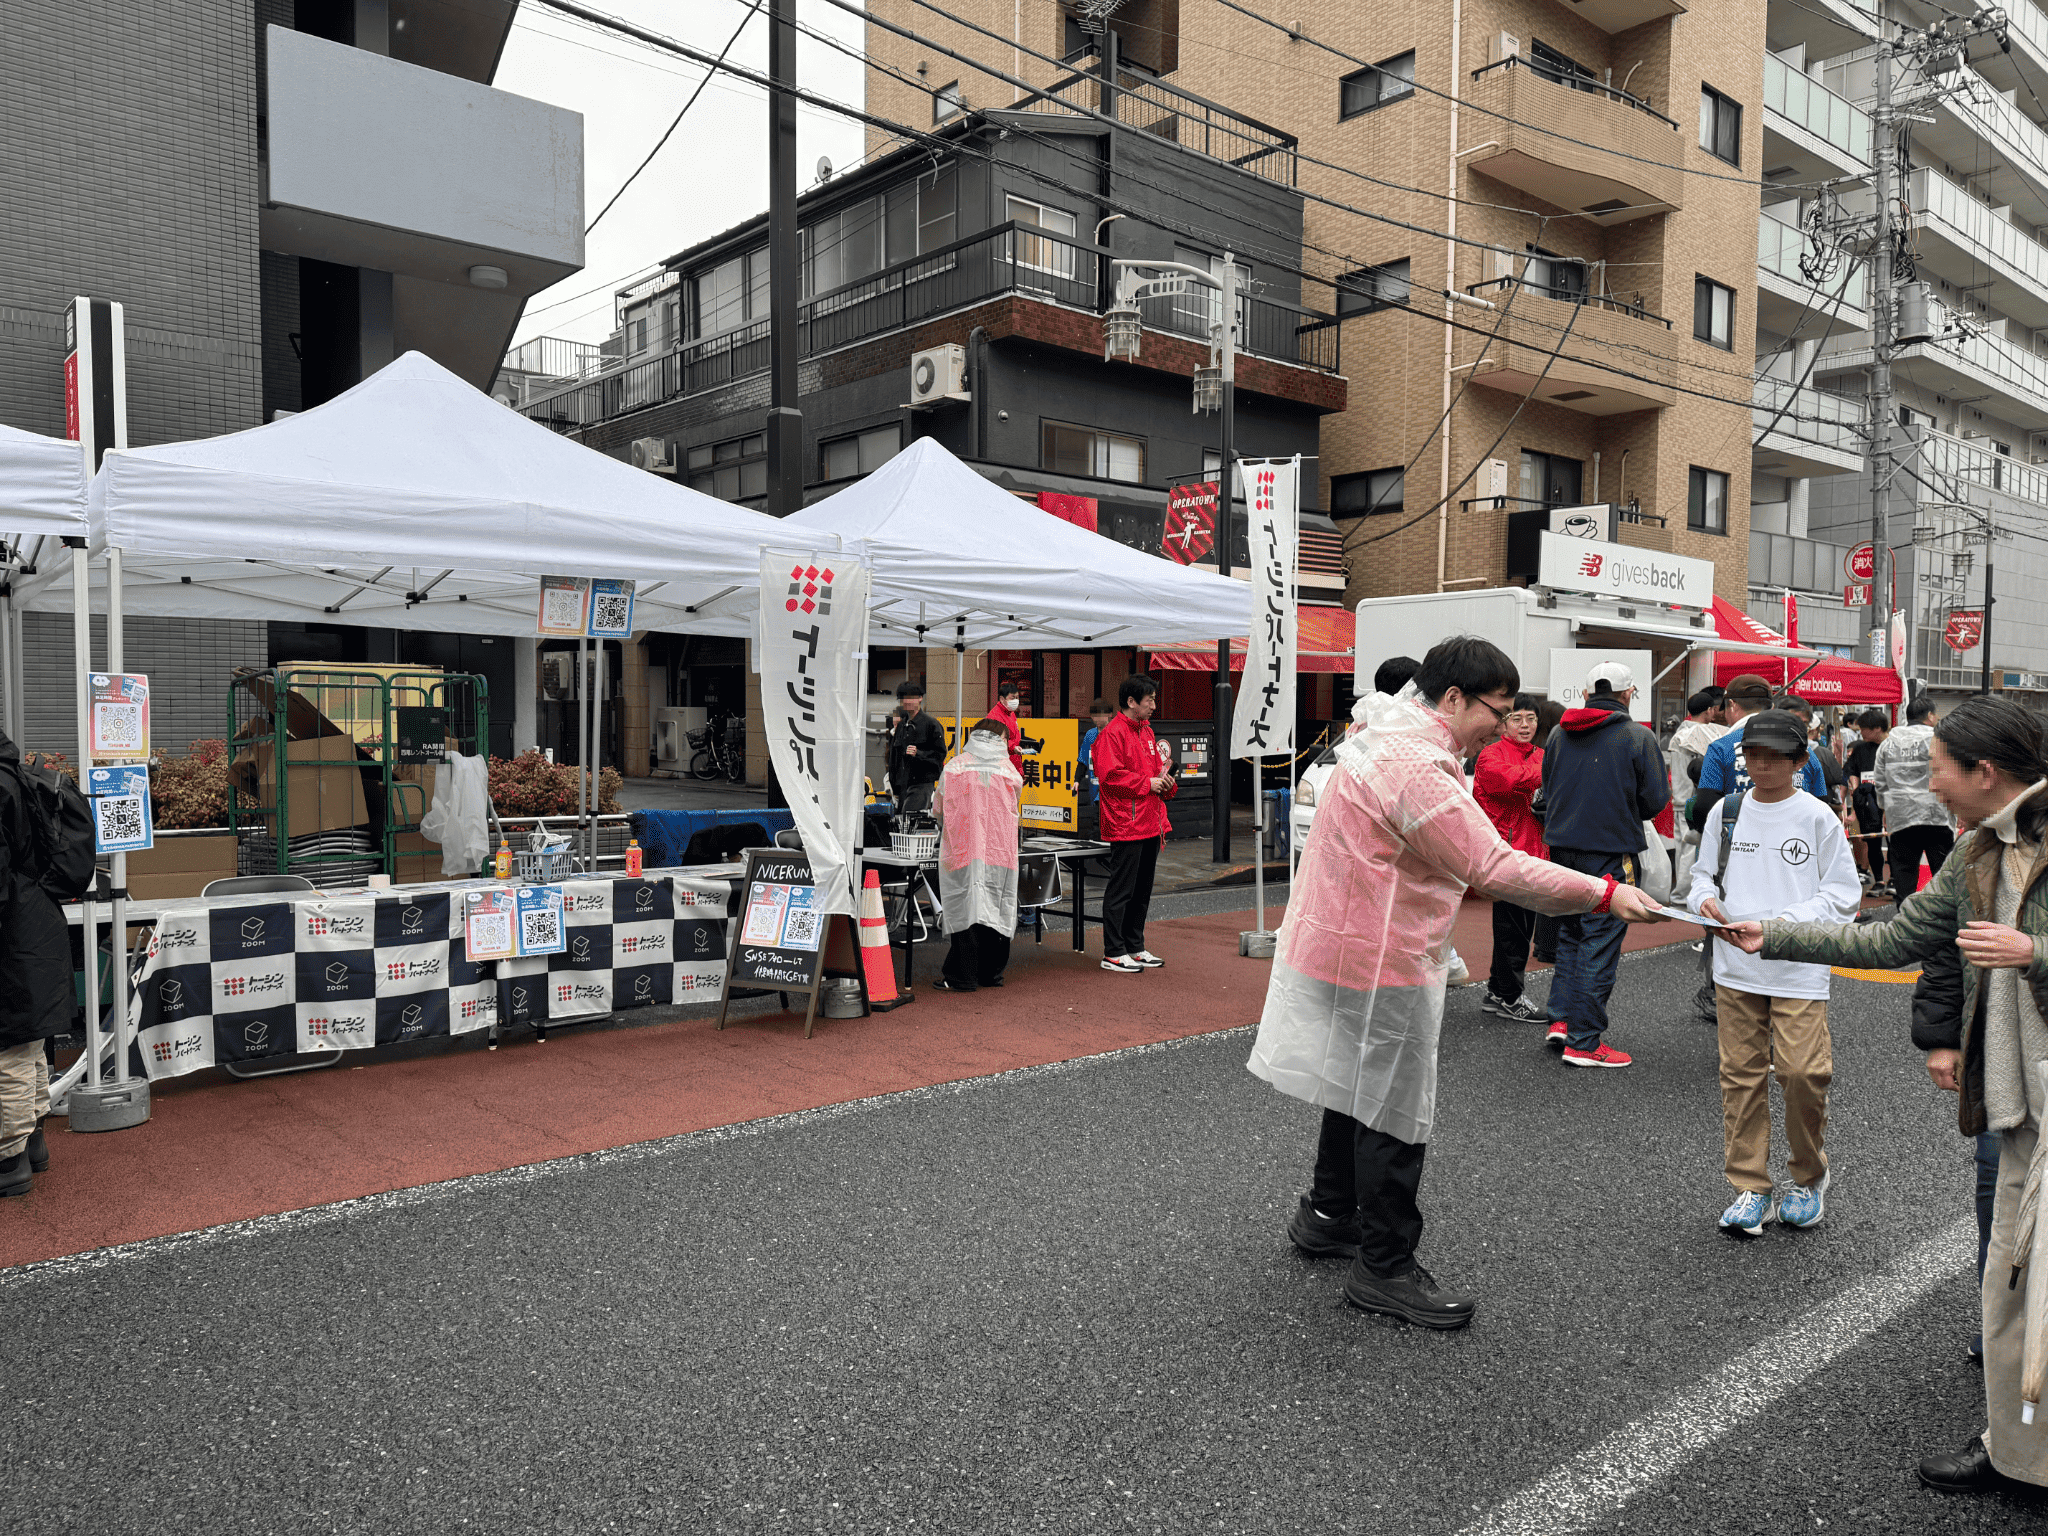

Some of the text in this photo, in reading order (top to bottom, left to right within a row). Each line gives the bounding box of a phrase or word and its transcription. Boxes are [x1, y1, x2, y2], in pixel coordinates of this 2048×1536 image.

[1172, 494, 1216, 509] OPERATOWN
[1854, 557, 1873, 571] 消火
[1813, 677, 1842, 692] balance
[1023, 808, 1047, 816] マクドナルド
[576, 895, 605, 905] トーシン
[697, 891, 722, 900] トーシン
[635, 905, 654, 913] ZOOM
[330, 917, 364, 927] トーシン
[402, 927, 423, 935] ZOOM
[160, 929, 197, 943] トーシン
[640, 935, 666, 944] トーシン
[241, 940, 266, 948] ZOOM
[409, 959, 440, 970] トーシン
[249, 972, 284, 985] トーシン
[695, 974, 722, 983] トーシン
[574, 984, 605, 993] トーシン
[163, 1002, 185, 1012] ZOOM
[332, 1016, 365, 1027] トーシン
[401, 1025, 423, 1033] ZOOM
[245, 1043, 269, 1052] ZOOM
